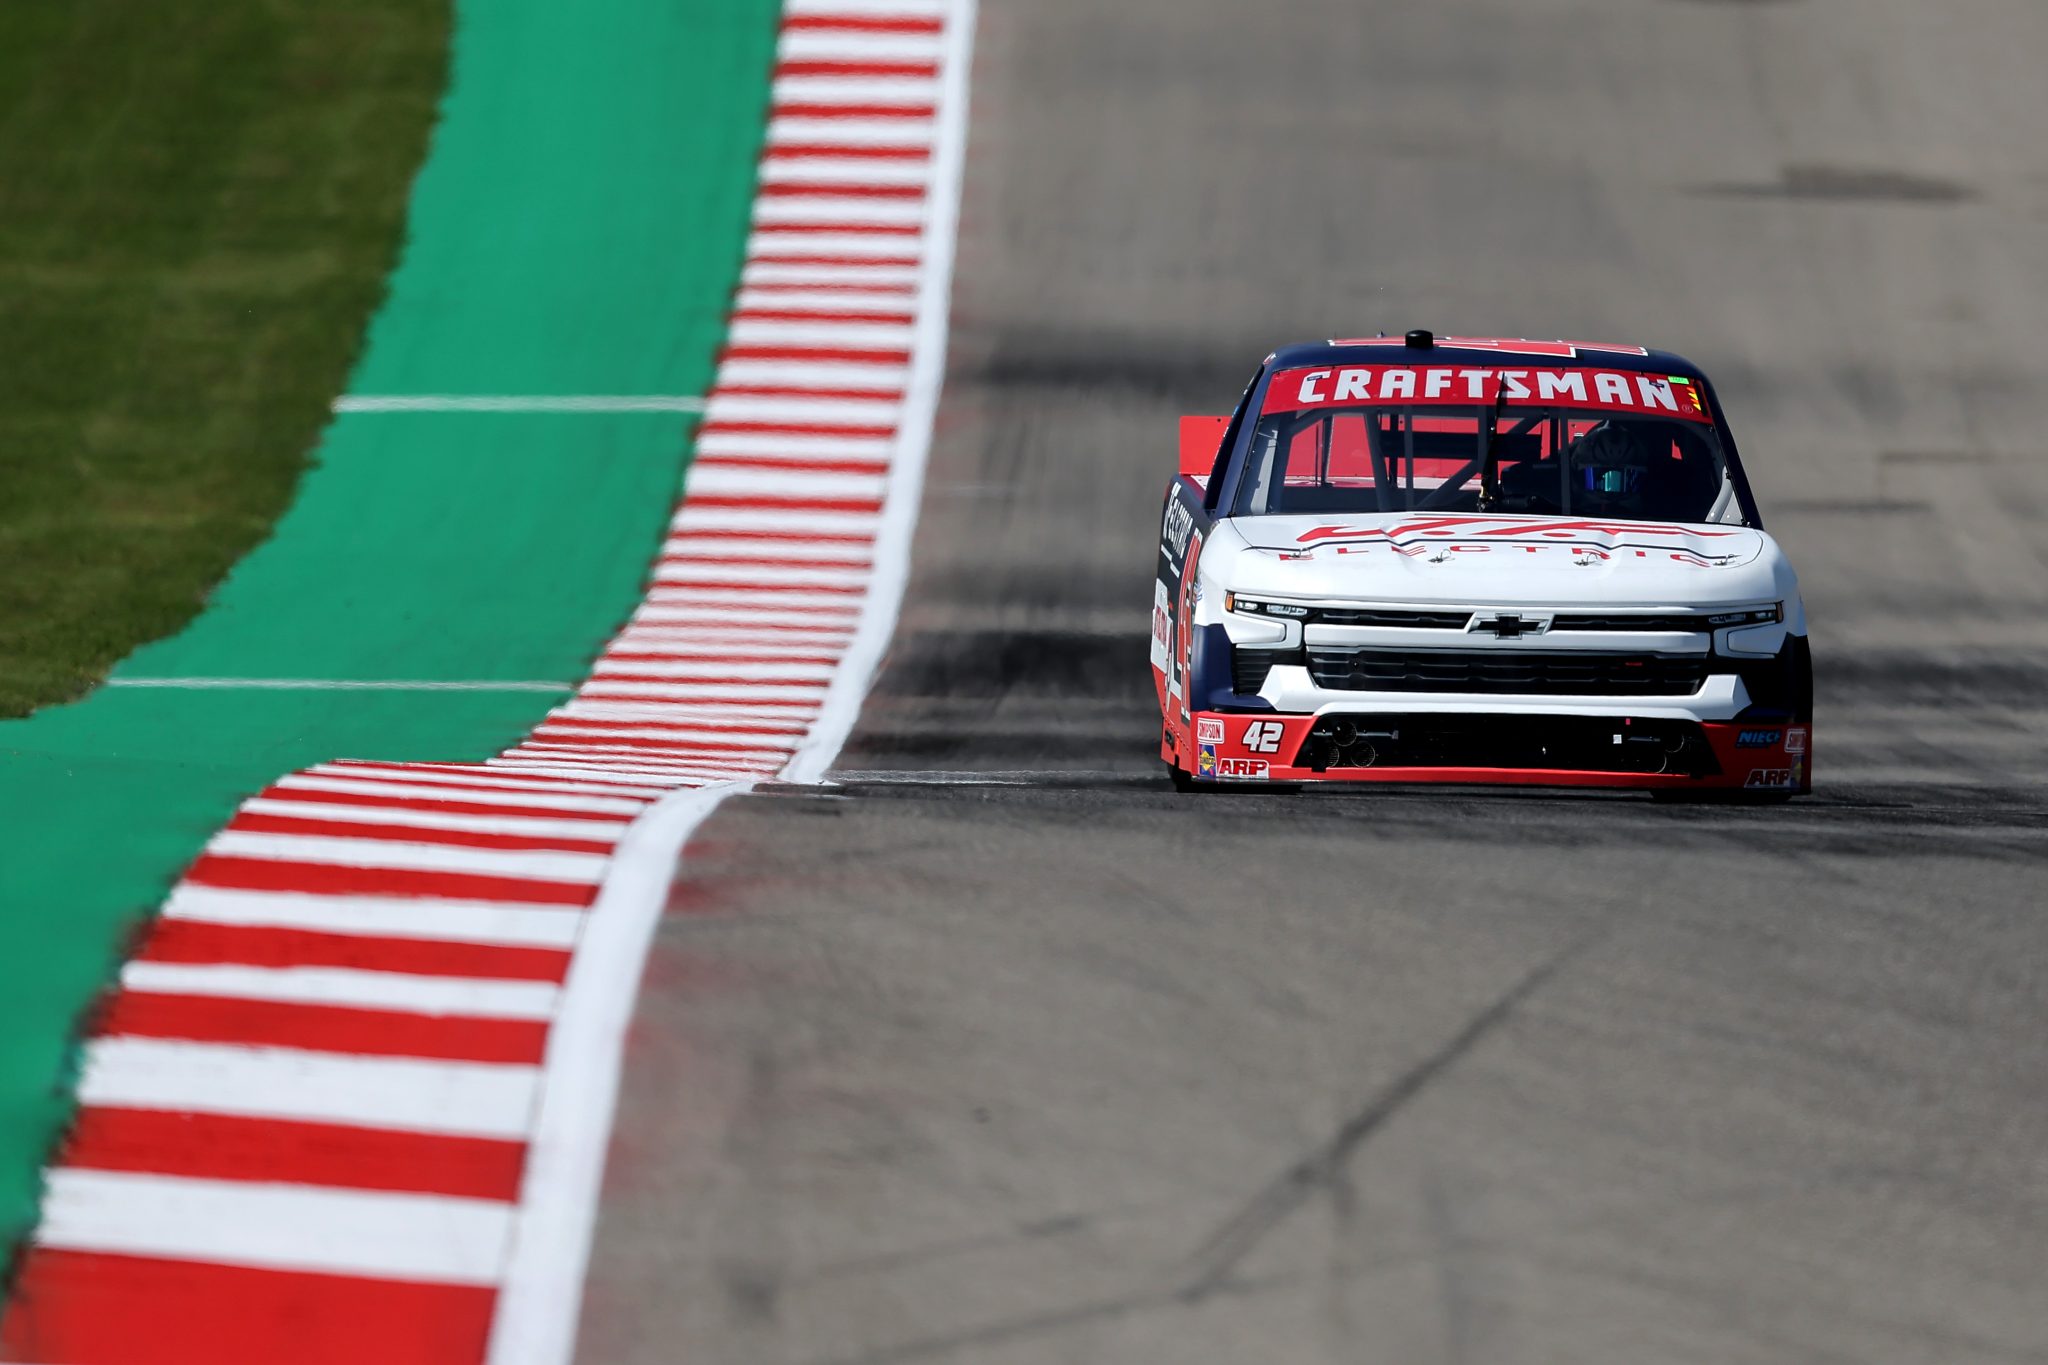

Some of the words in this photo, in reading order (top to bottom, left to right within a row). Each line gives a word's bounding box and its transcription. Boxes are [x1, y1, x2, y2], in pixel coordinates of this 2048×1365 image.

[1298, 369, 1679, 411] CRAFTSMAN
[1242, 721, 1284, 752] 42
[1219, 760, 1267, 775] ARP
[1746, 771, 1790, 785] ARP
